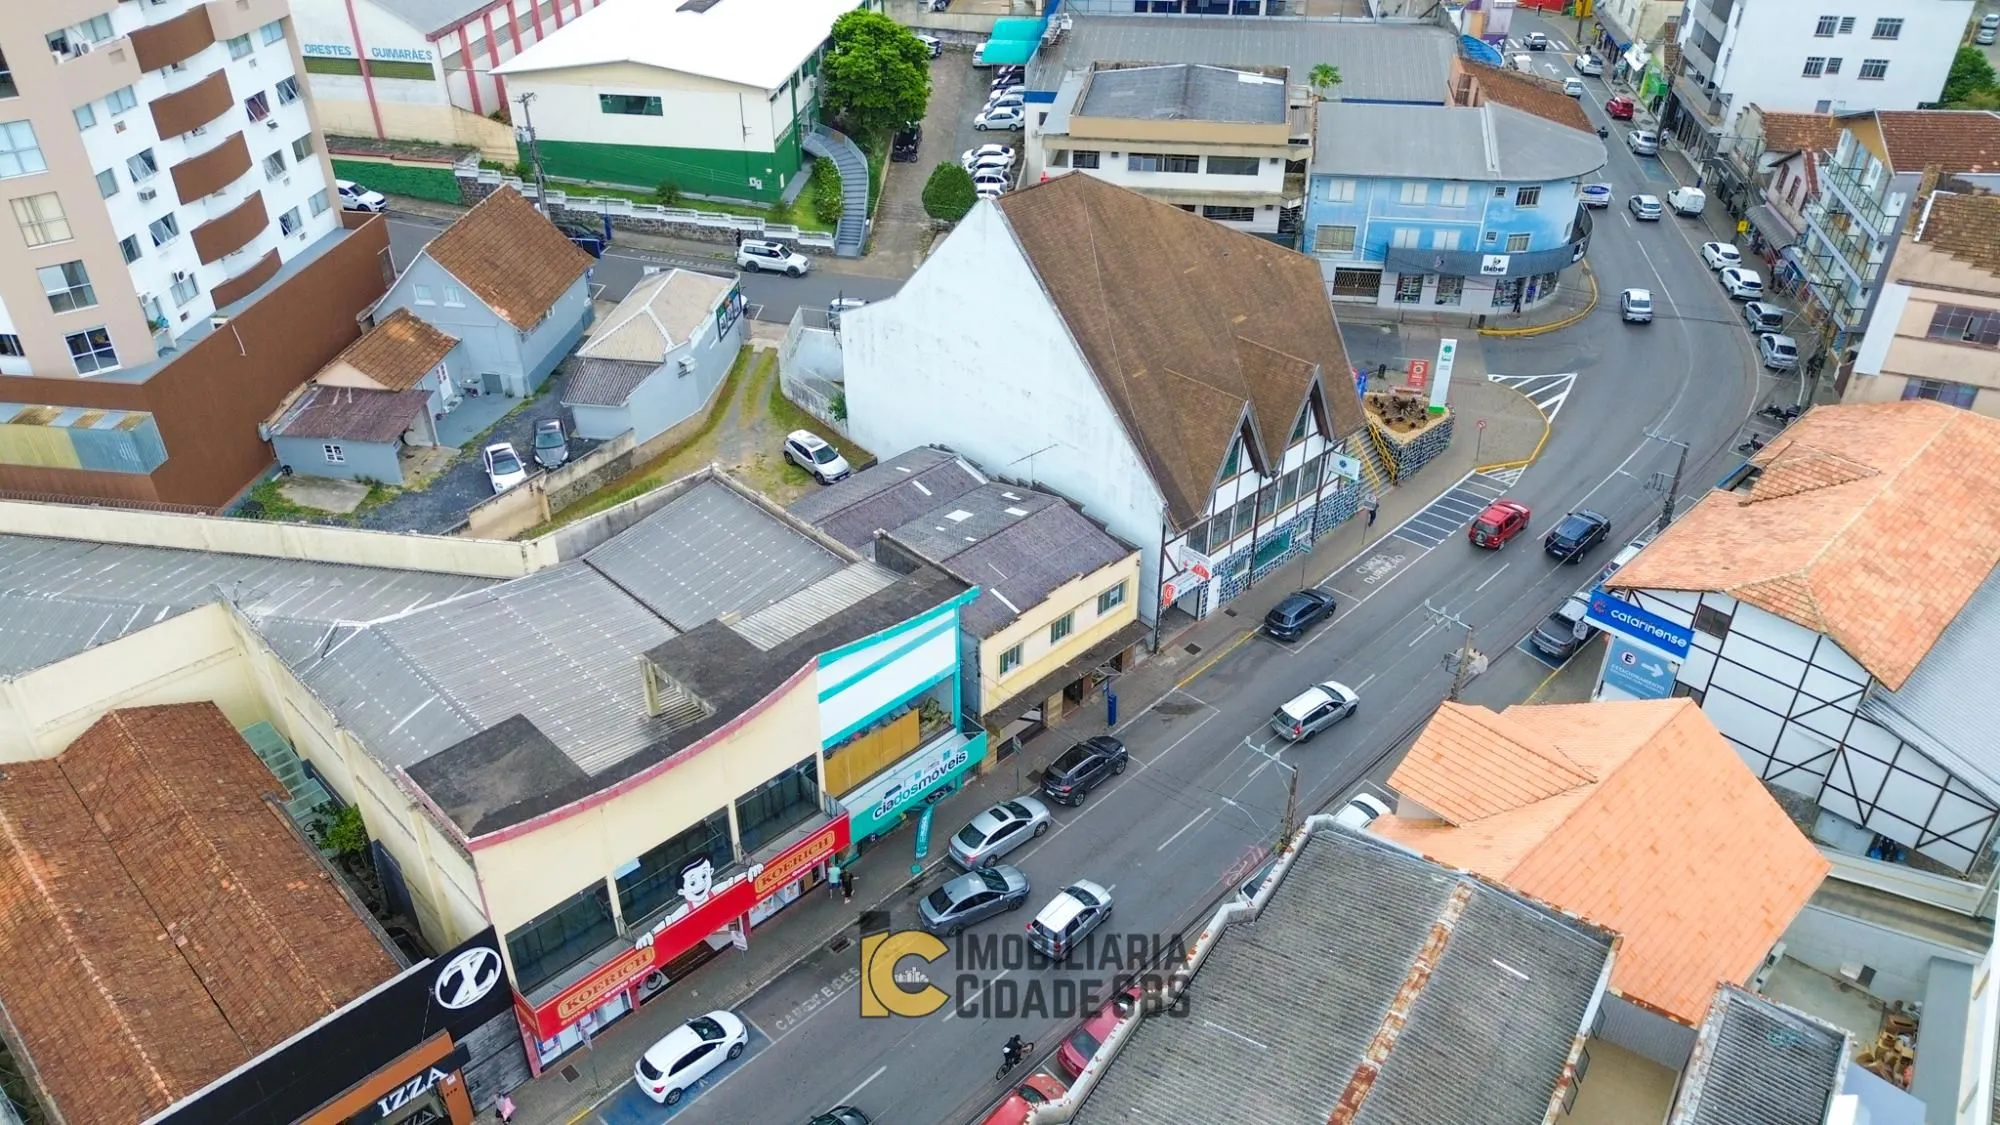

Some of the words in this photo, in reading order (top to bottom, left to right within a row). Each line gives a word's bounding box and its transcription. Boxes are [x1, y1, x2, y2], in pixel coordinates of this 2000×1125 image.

[304, 43, 352, 56] ORESTES
[1611, 609, 1687, 648] catarinense
[1624, 653, 1633, 664] E
[761, 837, 829, 885] KOERICH
[565, 953, 649, 1011] KOERICH
[377, 1067, 448, 1117] IZZA
